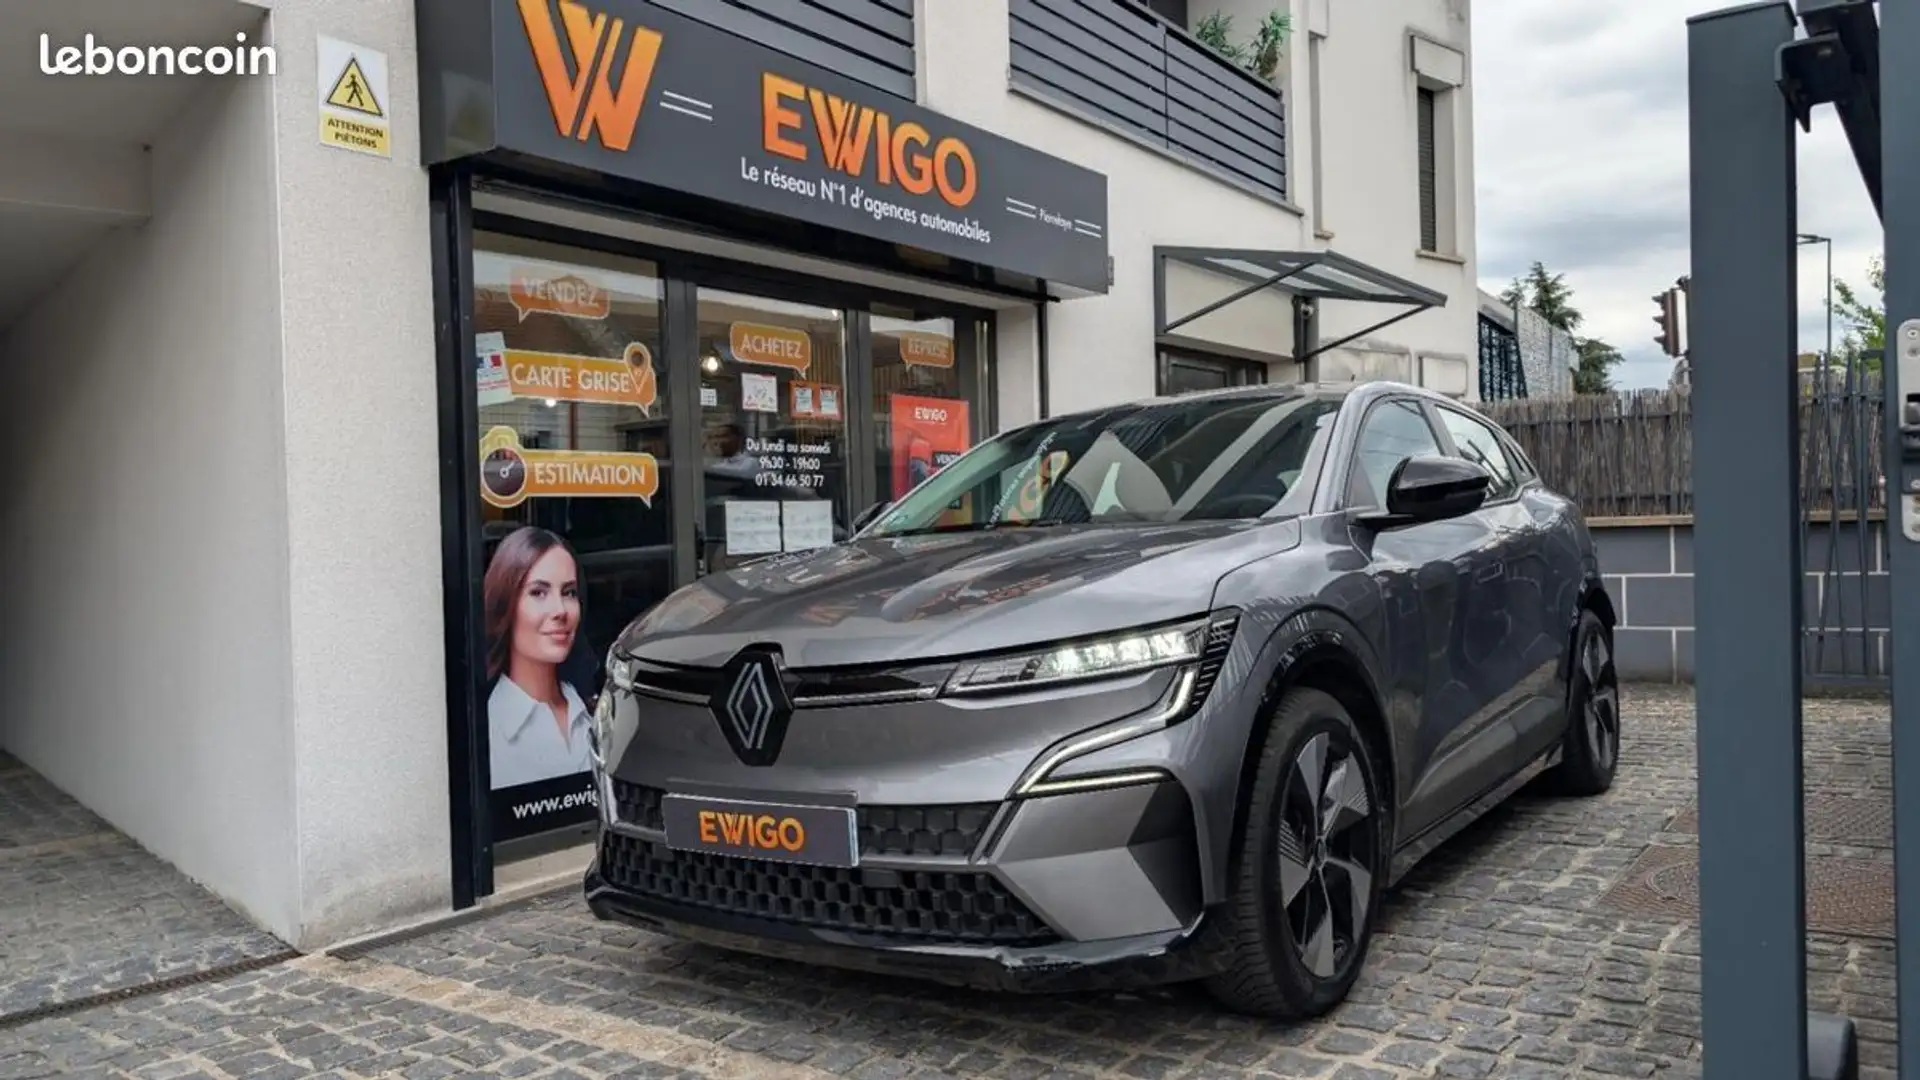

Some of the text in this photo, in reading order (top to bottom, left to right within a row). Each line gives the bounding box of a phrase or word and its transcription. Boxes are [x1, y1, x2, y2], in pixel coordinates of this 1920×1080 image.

[327, 117, 384, 139] ATTENTION
[761, 71, 977, 208] EWIGO
[740, 157, 760, 182] Le
[763, 165, 816, 198] réseau
[849, 189, 918, 226] d'agences
[920, 211, 991, 244] automobiles
[522, 277, 600, 307] VENDEZ
[740, 332, 804, 359] ACHETEZ
[511, 361, 572, 389] CARTE
[577, 367, 632, 394] GRISE
[914, 406, 948, 422] EWIGO
[746, 437, 831, 454] Du lundi au samedi
[534, 461, 646, 485] ESTIMATION
[759, 455, 784, 469] 9h30
[792, 457, 821, 470] 19h00
[755, 473, 825, 487] 01 34 66 50 77
[698, 811, 806, 851] EWIGO
